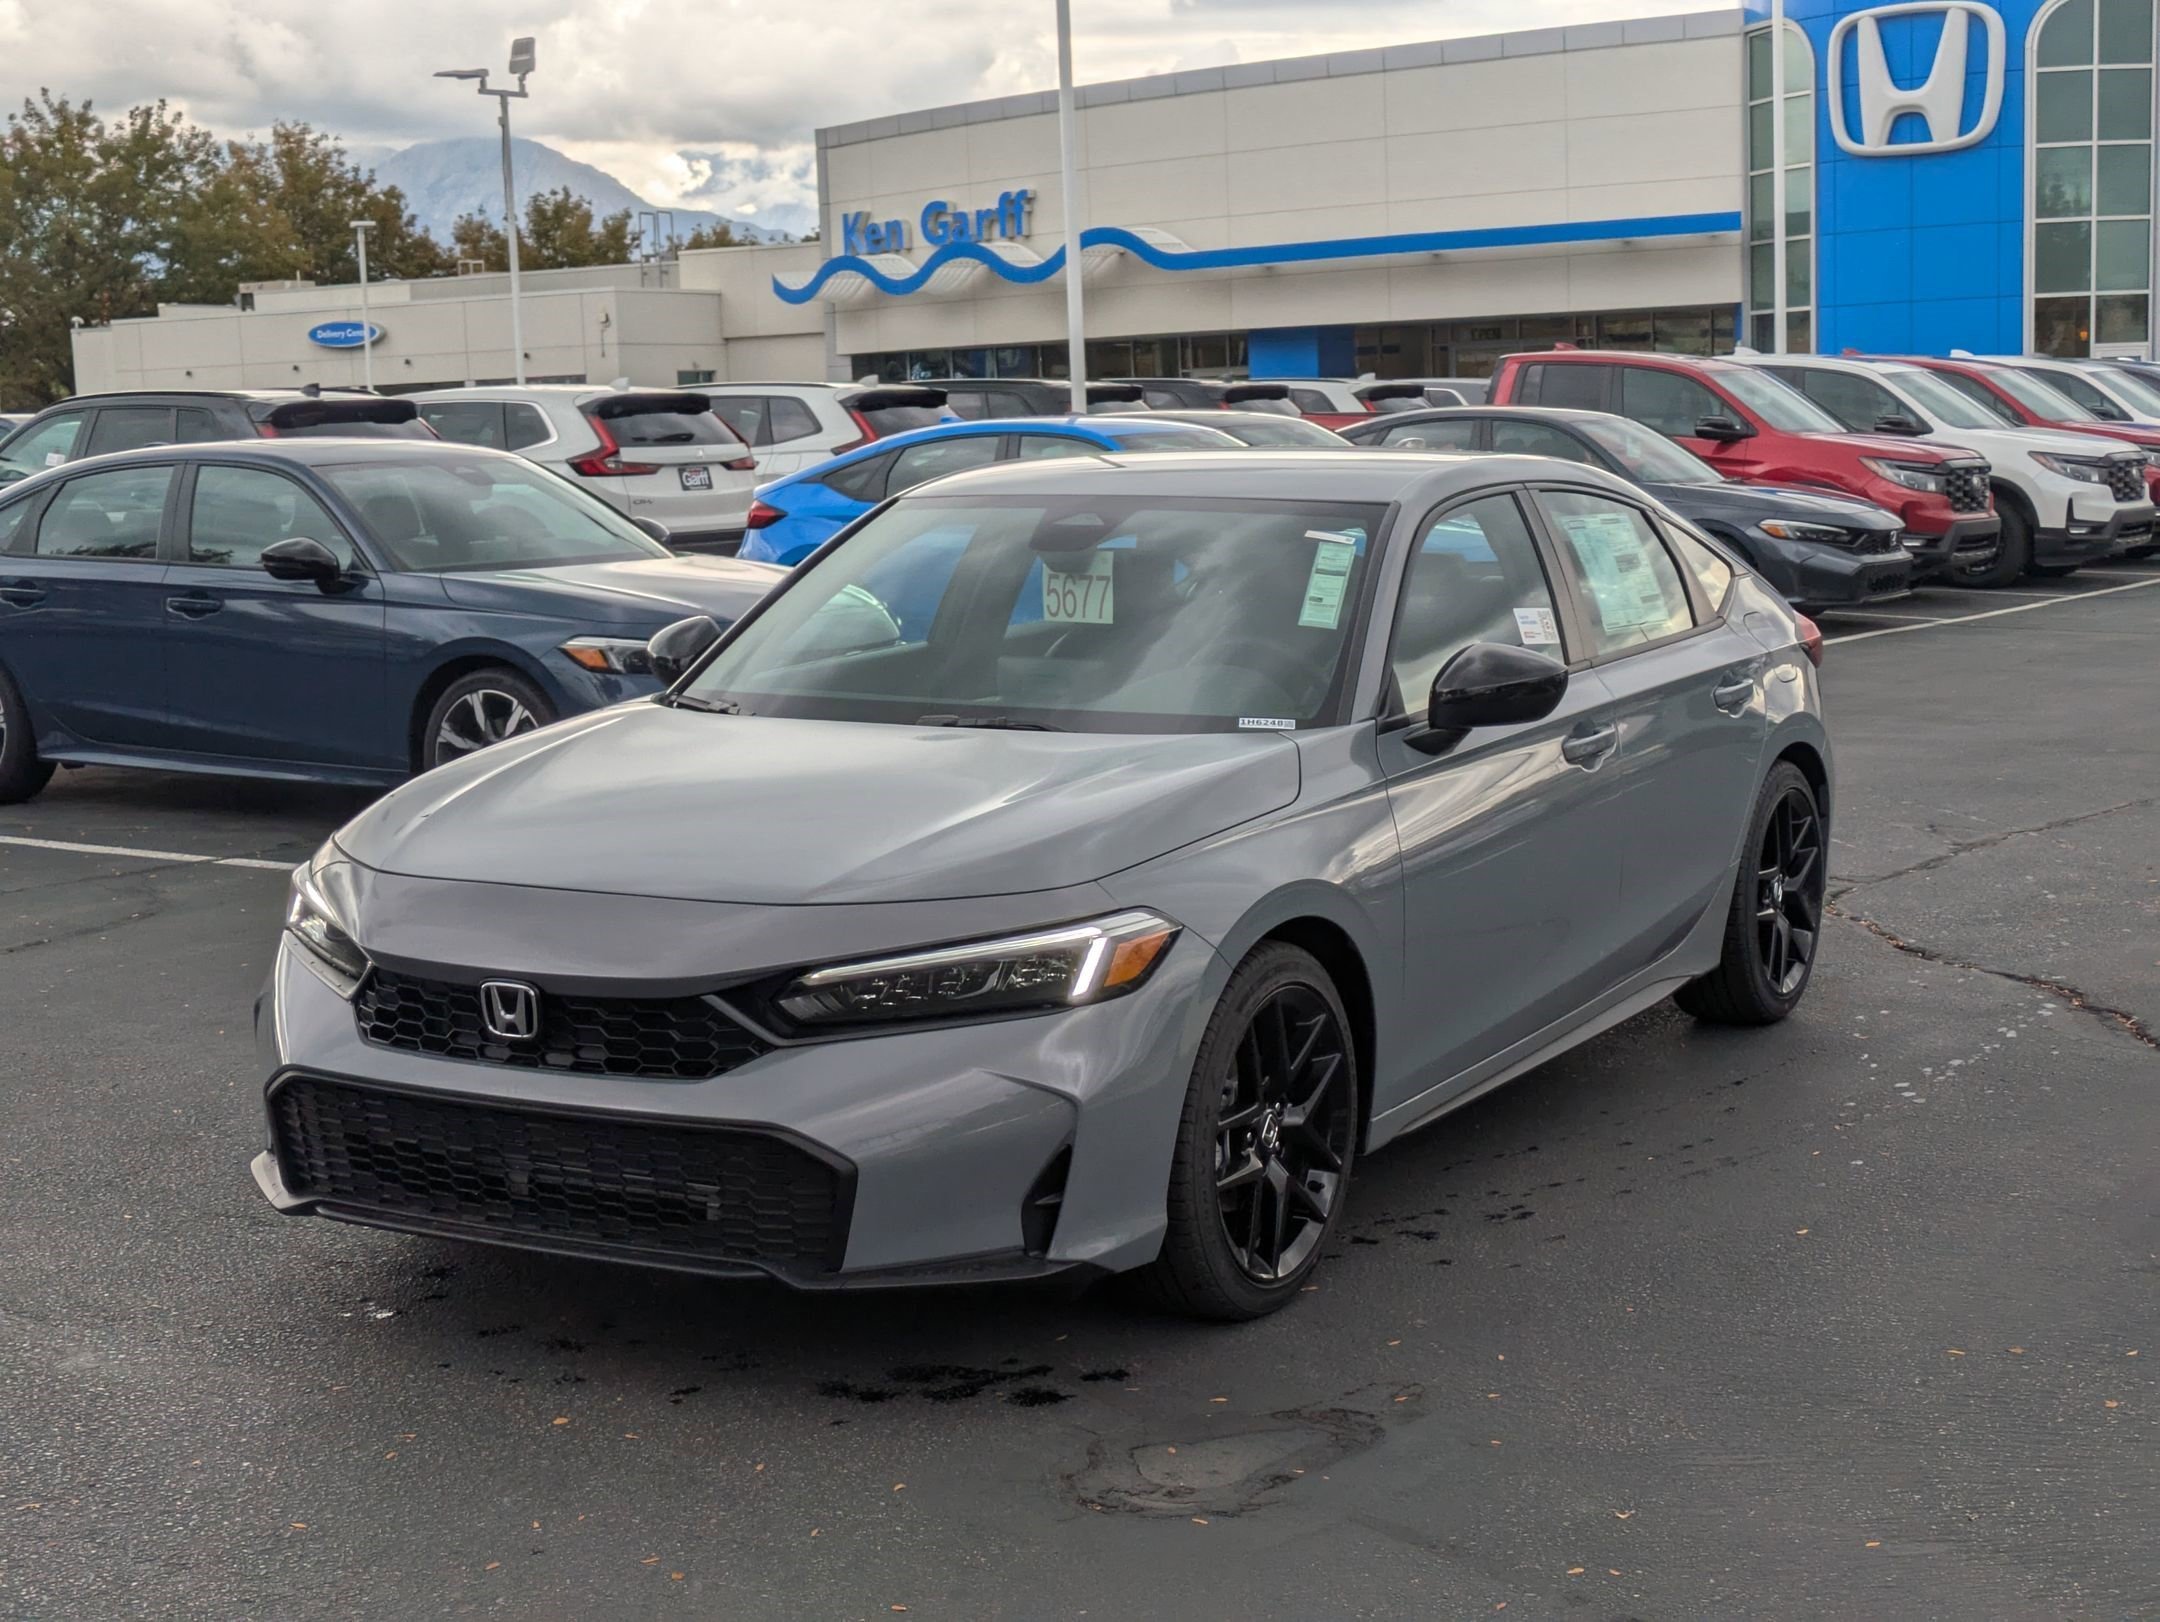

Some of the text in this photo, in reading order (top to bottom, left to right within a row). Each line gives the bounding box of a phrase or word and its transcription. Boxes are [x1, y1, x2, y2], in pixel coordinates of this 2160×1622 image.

[842, 189, 1032, 256] Ken Garff
[1046, 573, 1111, 619] 5677
